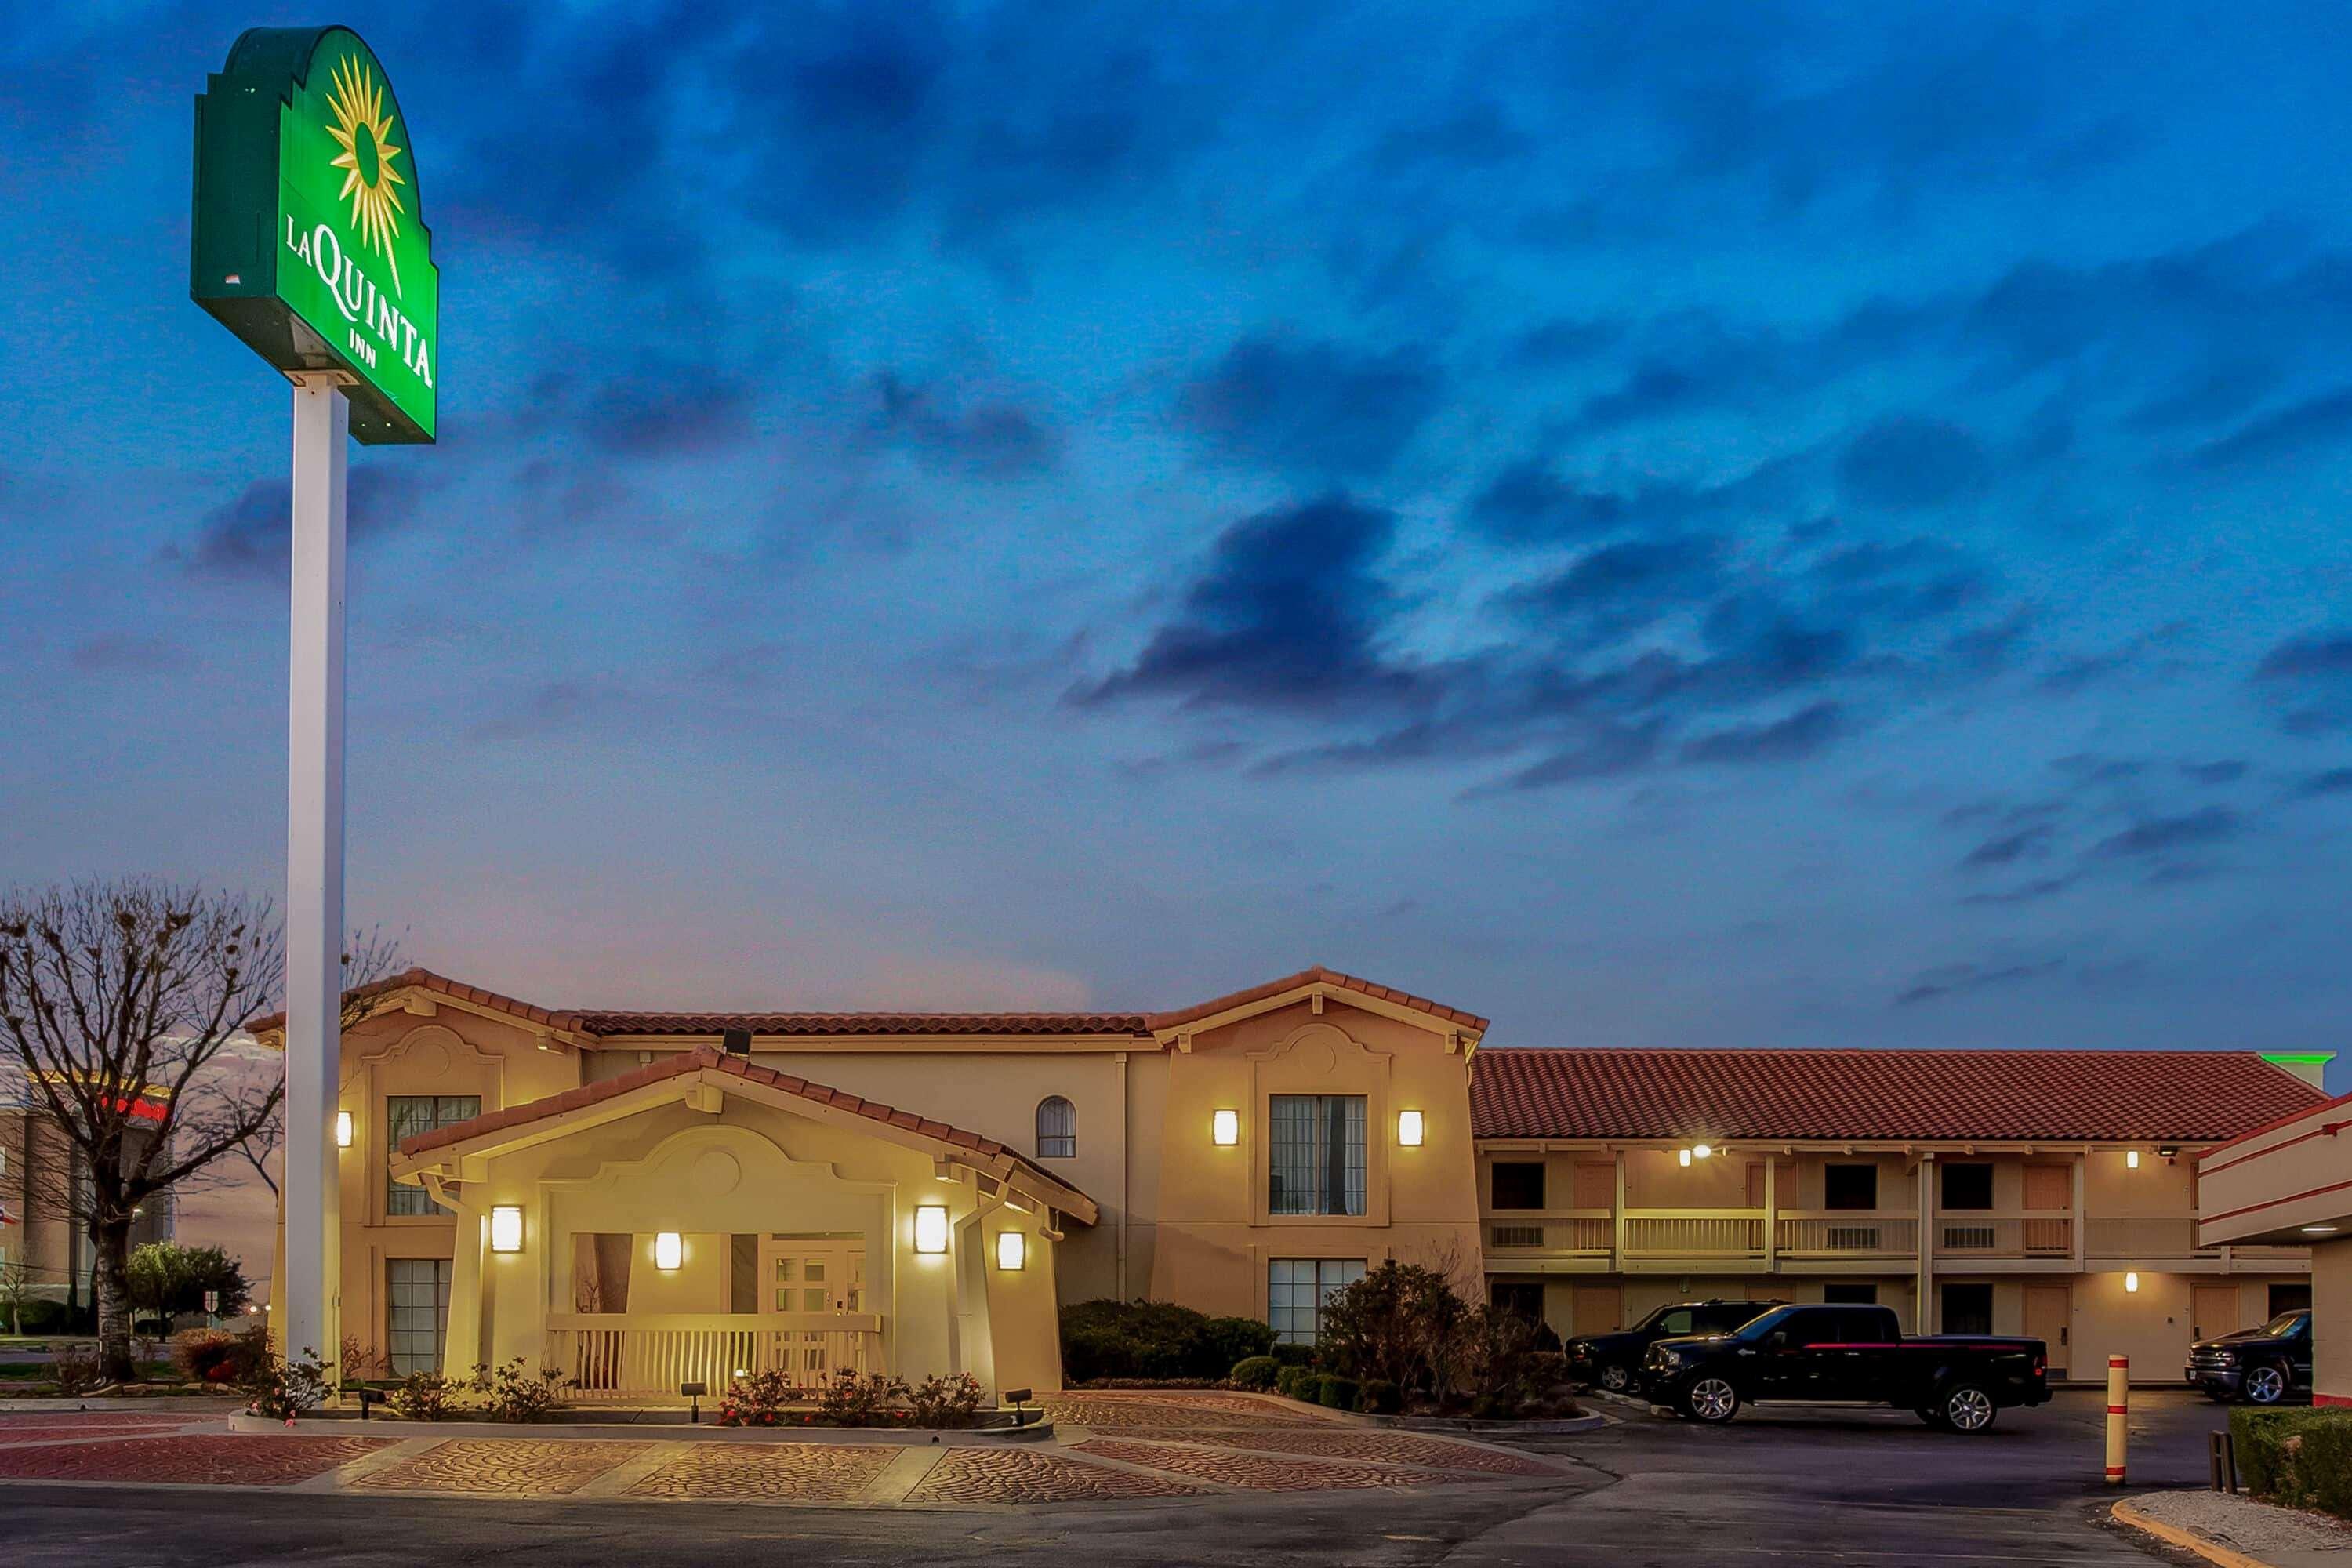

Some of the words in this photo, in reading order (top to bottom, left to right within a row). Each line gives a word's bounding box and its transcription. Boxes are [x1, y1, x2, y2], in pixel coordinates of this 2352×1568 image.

[286, 213, 313, 267] LA
[313, 223, 434, 390] QUINTA
[350, 327, 376, 369] INN
